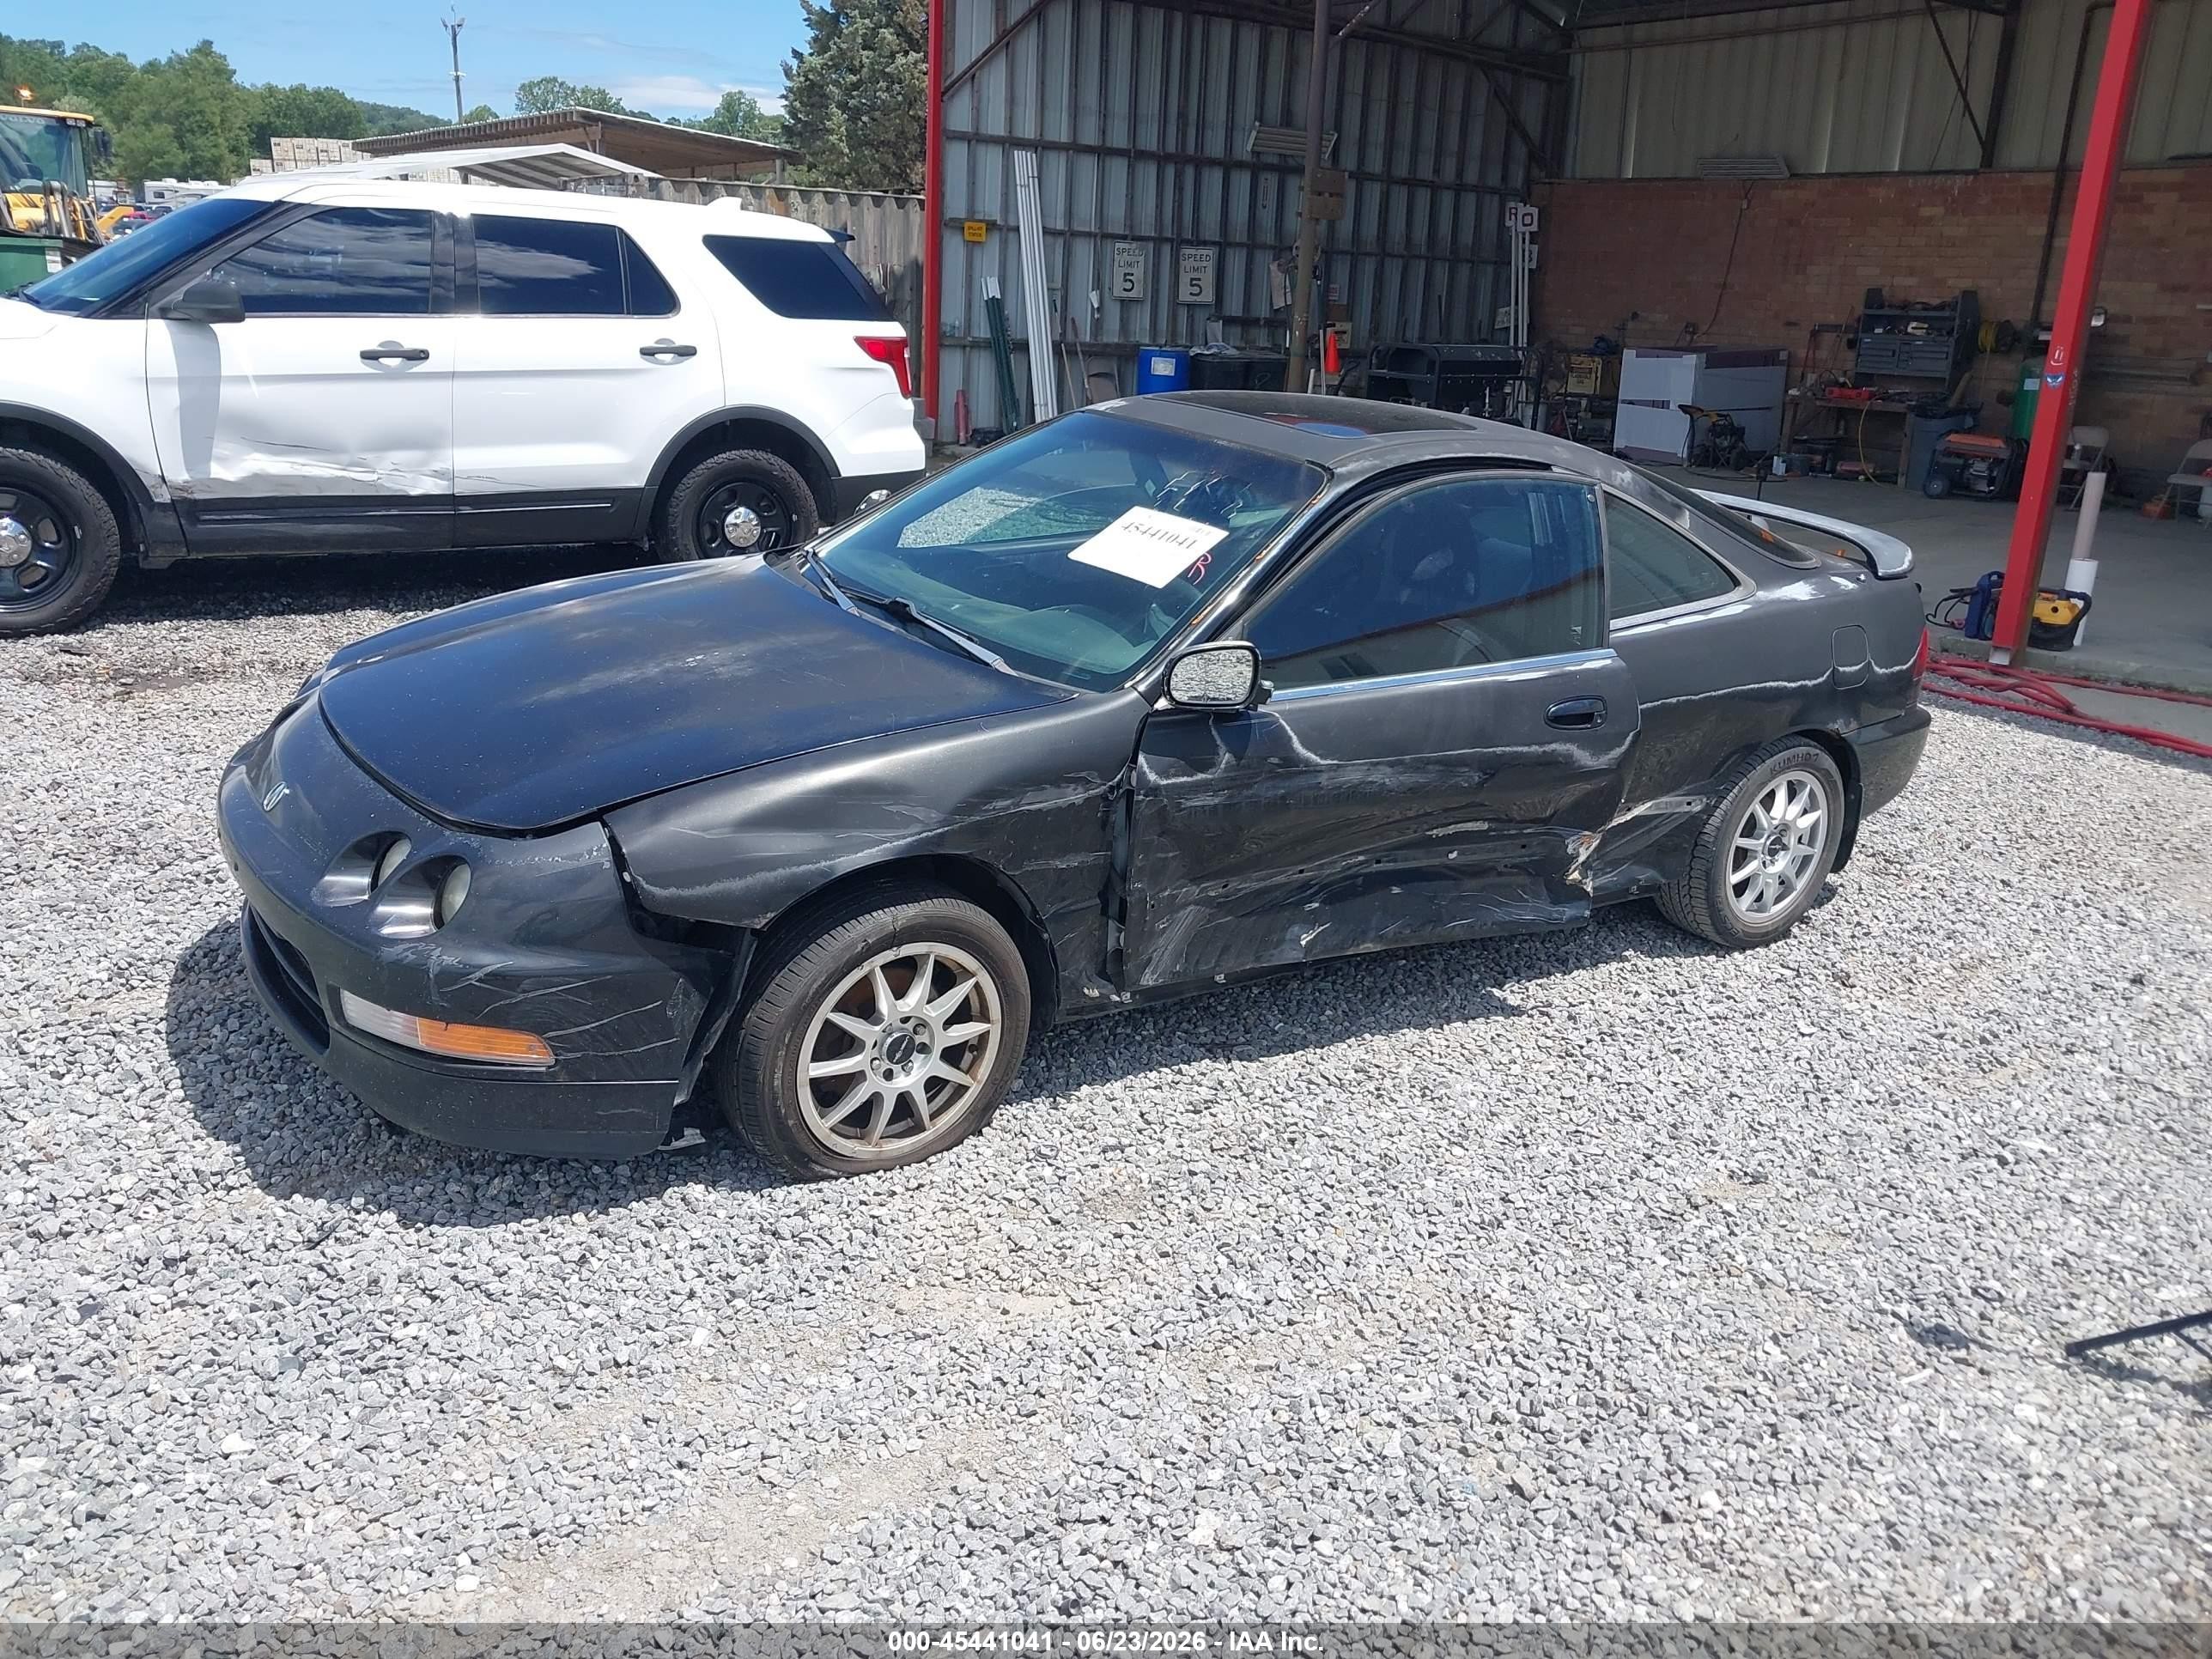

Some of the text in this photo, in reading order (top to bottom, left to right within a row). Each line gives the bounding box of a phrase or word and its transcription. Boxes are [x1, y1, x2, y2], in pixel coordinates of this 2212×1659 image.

[1115, 247, 1145, 258] SPEED
[1181, 253, 1212, 263] SPEED
[1118, 260, 1140, 270] LIMIT
[1184, 265, 1208, 275] LIMIT
[1121, 271, 1135, 293] 5
[1188, 276, 1203, 297] 5
